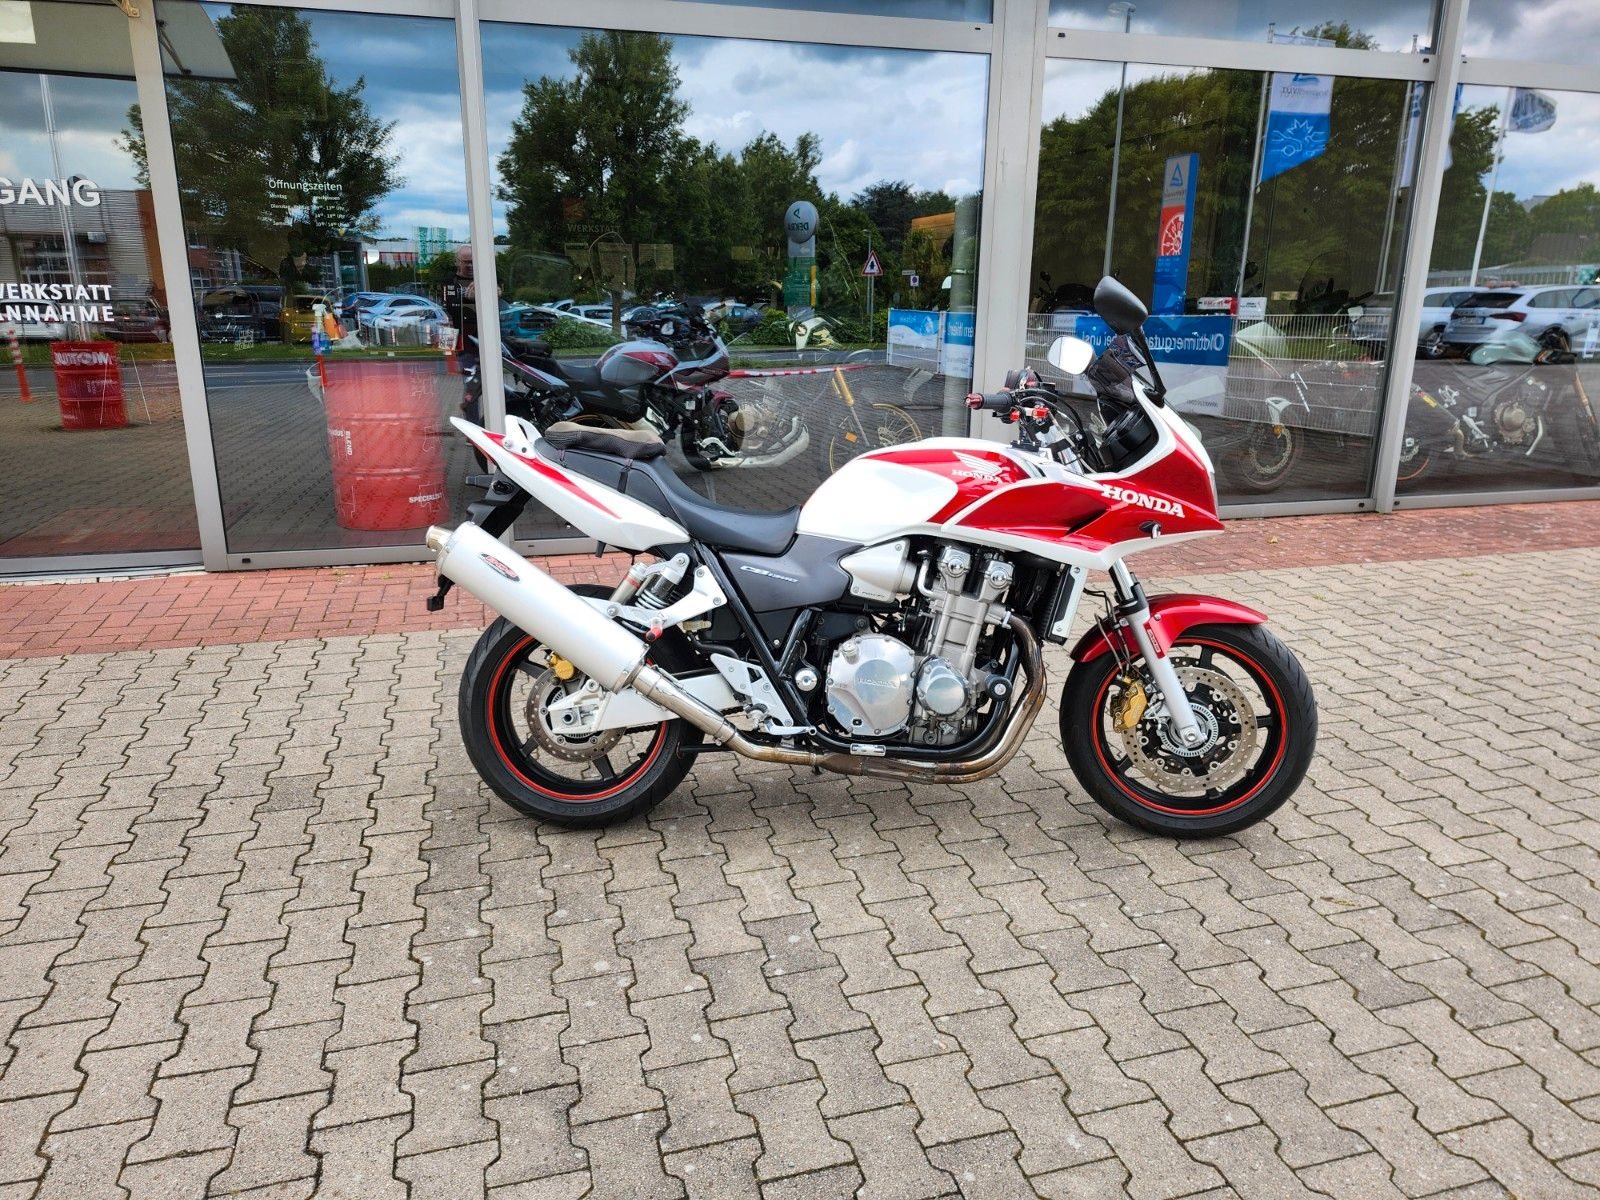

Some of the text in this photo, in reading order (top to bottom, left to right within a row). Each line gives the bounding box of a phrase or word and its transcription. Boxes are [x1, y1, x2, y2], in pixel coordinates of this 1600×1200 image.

[0, 178, 101, 207] GANG
[268, 178, 343, 192] Öffnungszeiten
[567, 224, 621, 233] WERKSTATT
[951, 469, 1001, 484] HONDA
[1100, 484, 1186, 518] HONDA
